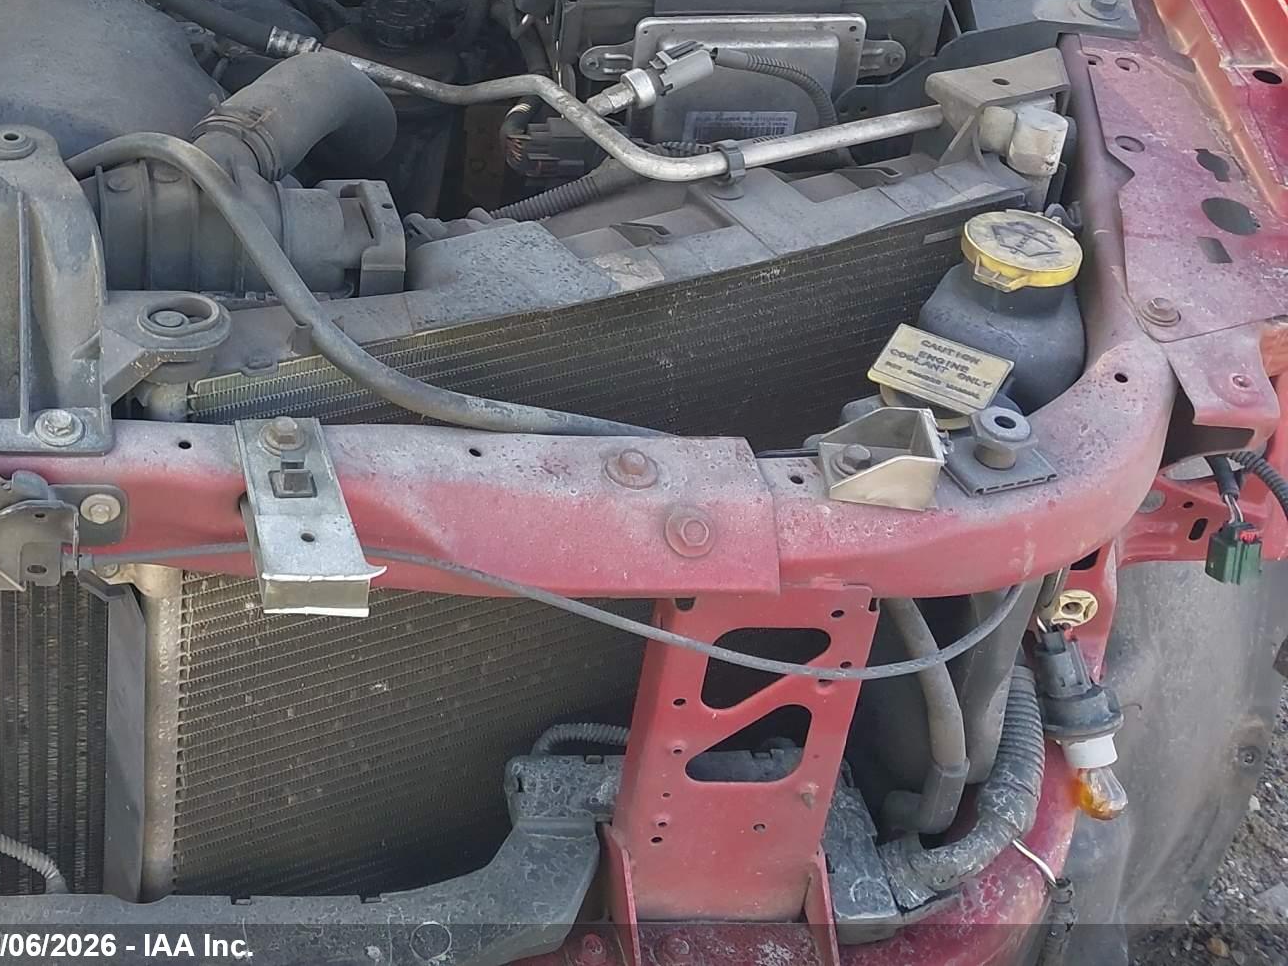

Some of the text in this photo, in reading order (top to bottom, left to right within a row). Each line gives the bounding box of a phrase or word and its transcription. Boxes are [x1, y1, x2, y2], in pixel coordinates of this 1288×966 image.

[918, 350, 970, 373] ENGINE
[921, 339, 981, 365] CAUTION
[890, 348, 949, 373] COOLANT
[957, 373, 993, 389] ONLY
